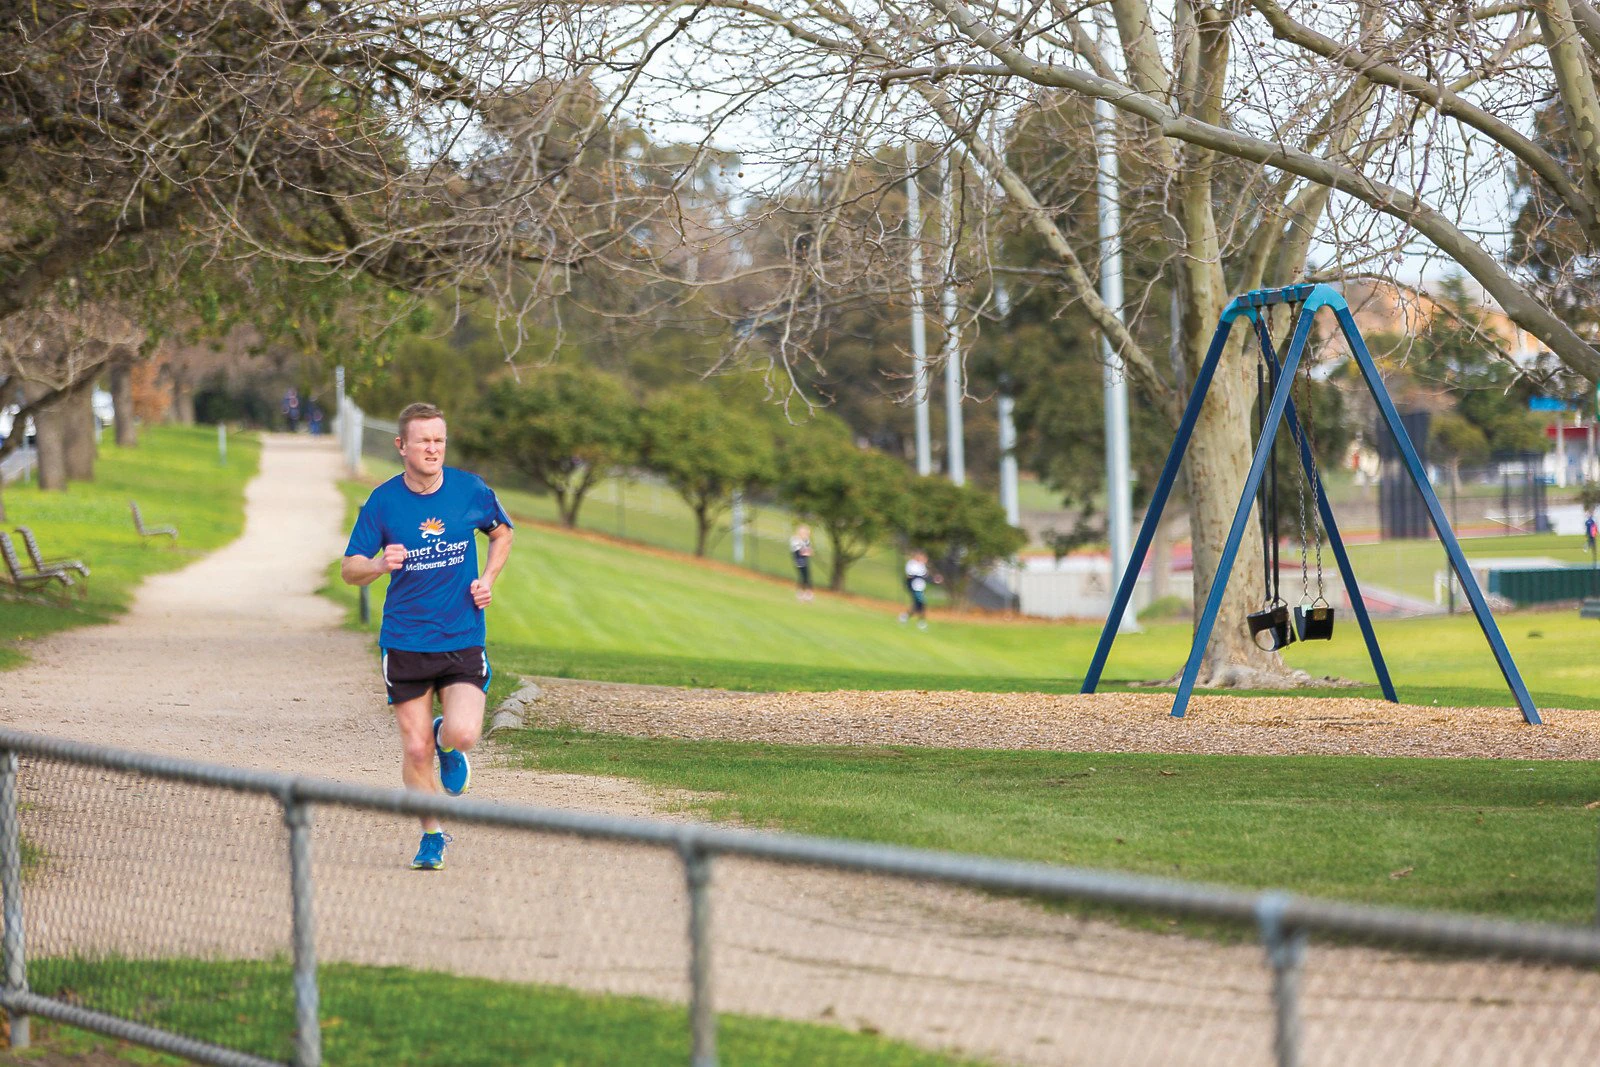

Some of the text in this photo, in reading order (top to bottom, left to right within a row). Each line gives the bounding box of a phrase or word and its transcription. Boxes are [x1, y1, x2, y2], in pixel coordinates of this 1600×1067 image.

[405, 546, 432, 558] mer
[435, 540, 469, 553] Casey
[405, 560, 447, 571] Melbourne
[447, 554, 465, 566] 2015
